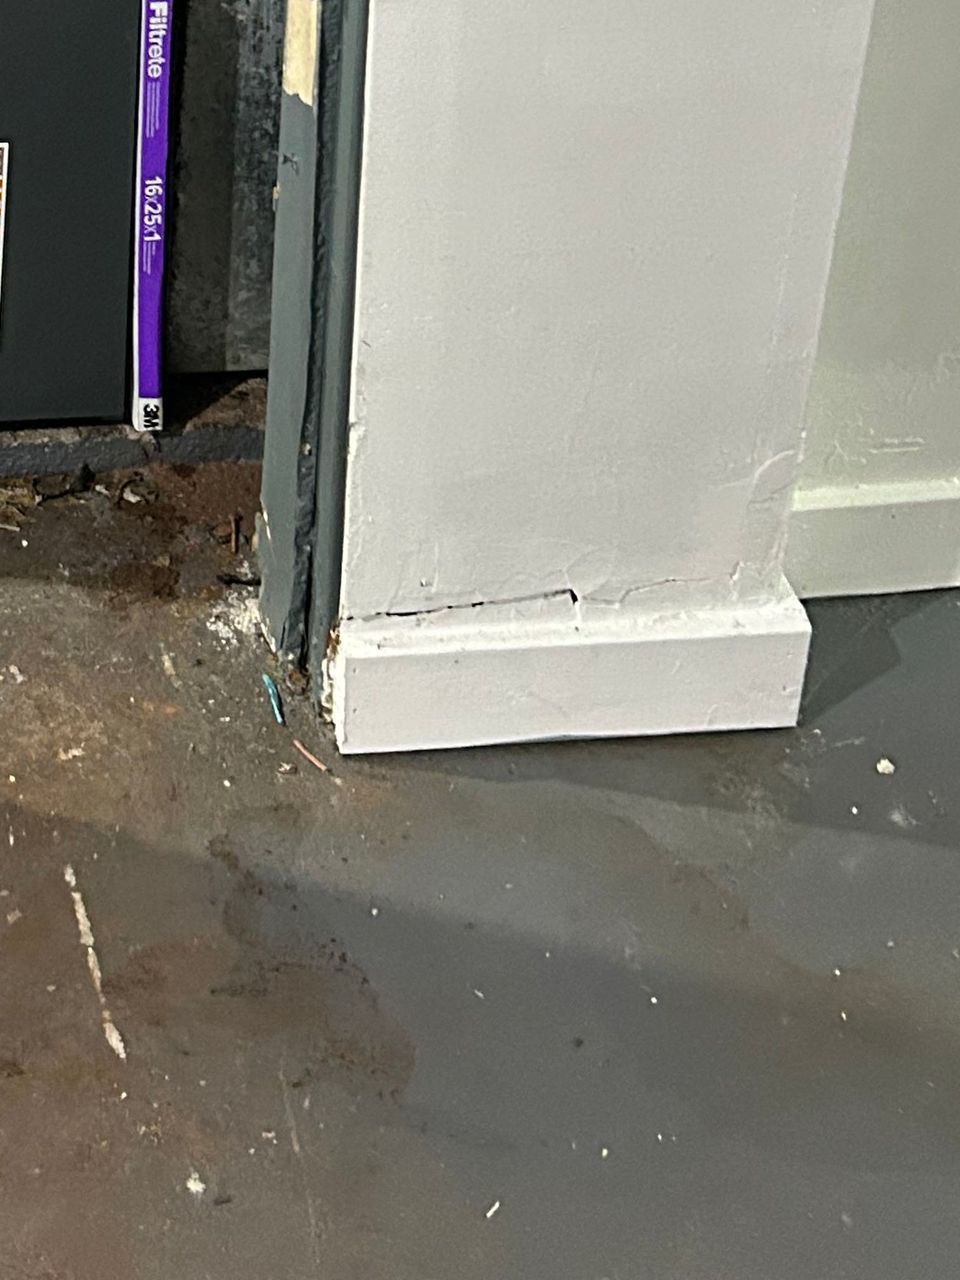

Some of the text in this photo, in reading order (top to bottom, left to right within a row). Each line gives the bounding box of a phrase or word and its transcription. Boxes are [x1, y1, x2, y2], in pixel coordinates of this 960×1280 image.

[148, 2, 169, 78] Filtrete
[144, 176, 163, 241] 16x25x1
[144, 404, 159, 428] 3M
